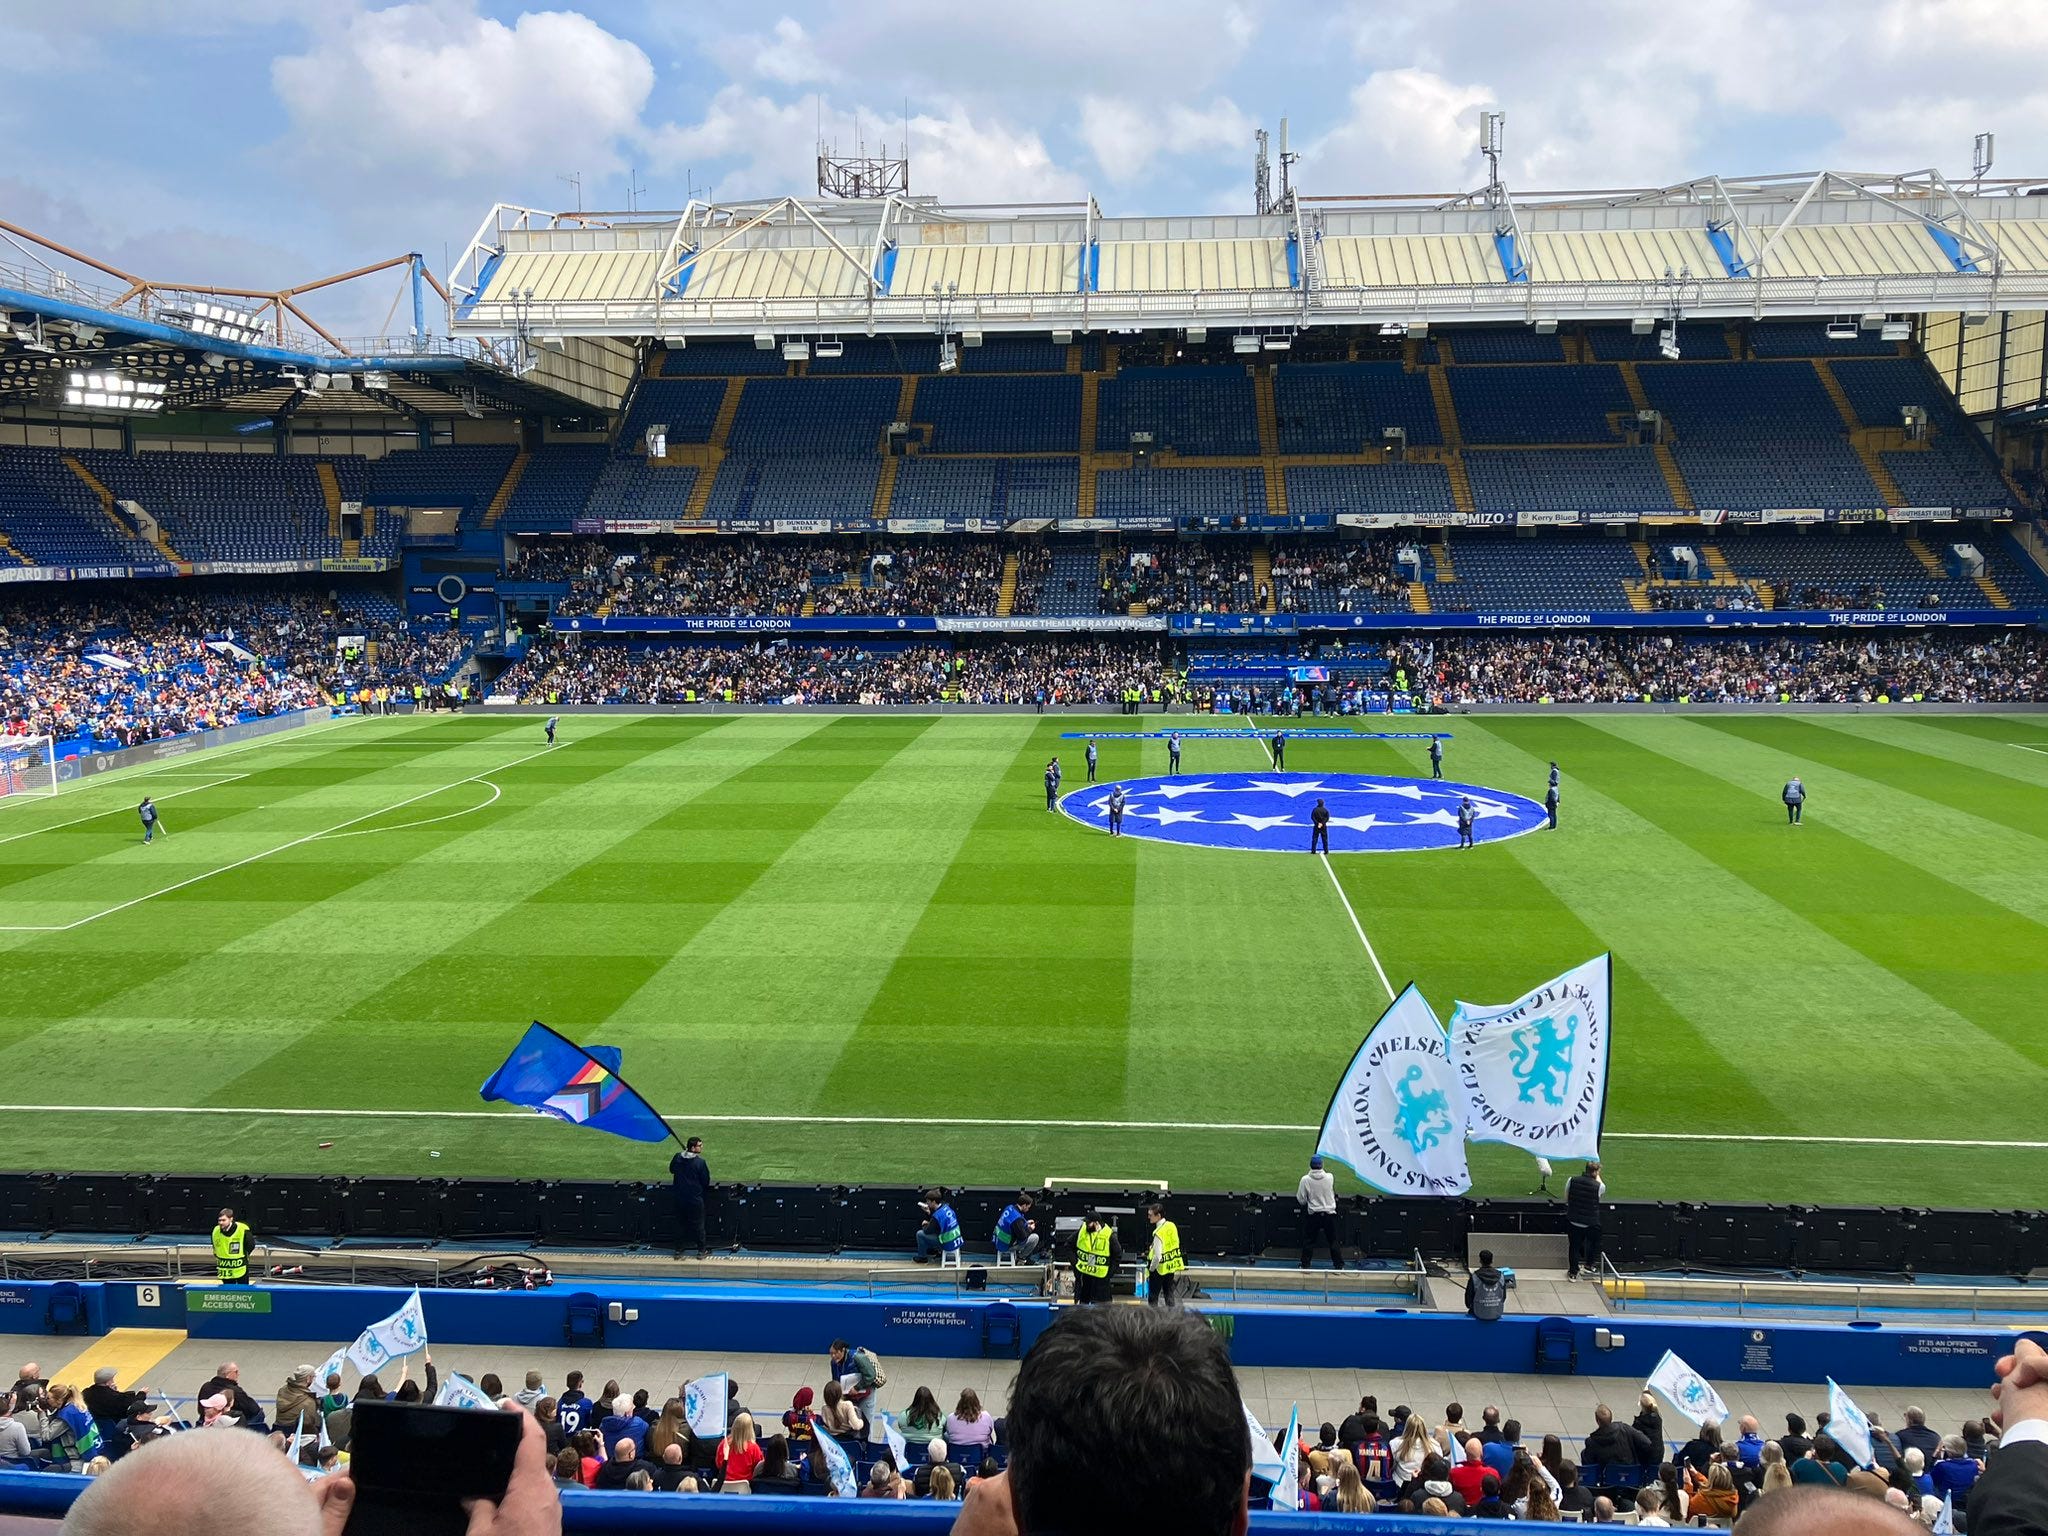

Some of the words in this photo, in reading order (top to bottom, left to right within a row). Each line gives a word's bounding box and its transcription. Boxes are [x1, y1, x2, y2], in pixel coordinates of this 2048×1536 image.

[49, 428, 59, 437] 15
[320, 437, 330, 446] 16
[1468, 513, 1505, 524] MIZO
[1532, 514, 1553, 522] Kerry
[1728, 510, 1760, 518] FRANCE
[78, 568, 98, 579] TAKING
[99, 567, 109, 578] THE
[110, 567, 125, 578] MIKEL
[1477, 615, 1497, 624] THE
[1500, 615, 1531, 624] PRIDE
[1533, 615, 1544, 623] OF
[1546, 614, 1591, 624] LONDON
[1829, 613, 1850, 622] THE
[1852, 613, 1885, 622] PRIDE
[1887, 613, 1898, 621] OF
[1900, 613, 1947, 622] LONDON
[686, 619, 705, 628] THE
[706, 619, 736, 628] PRIDE
[738, 619, 748, 627] OF
[750, 619, 791, 628] LONDON
[956, 621, 981, 629] THEY
[1010, 620, 1038, 628] MAKE
[1039, 619, 1066, 628] THEM
[1088, 619, 1108, 628] RAY
[1353, 1082, 1402, 1178] NOTHING
[1077, 1249, 1107, 1266] STEWRD
[142, 1287, 155, 1304] 6
[202, 1301, 234, 1309] ACCESS
[927, 1311, 956, 1319] OFFENCE
[1908, 1345, 1918, 1353] TO
[560, 1411, 580, 1433] 19
[1365, 1460, 1382, 1482] 4
